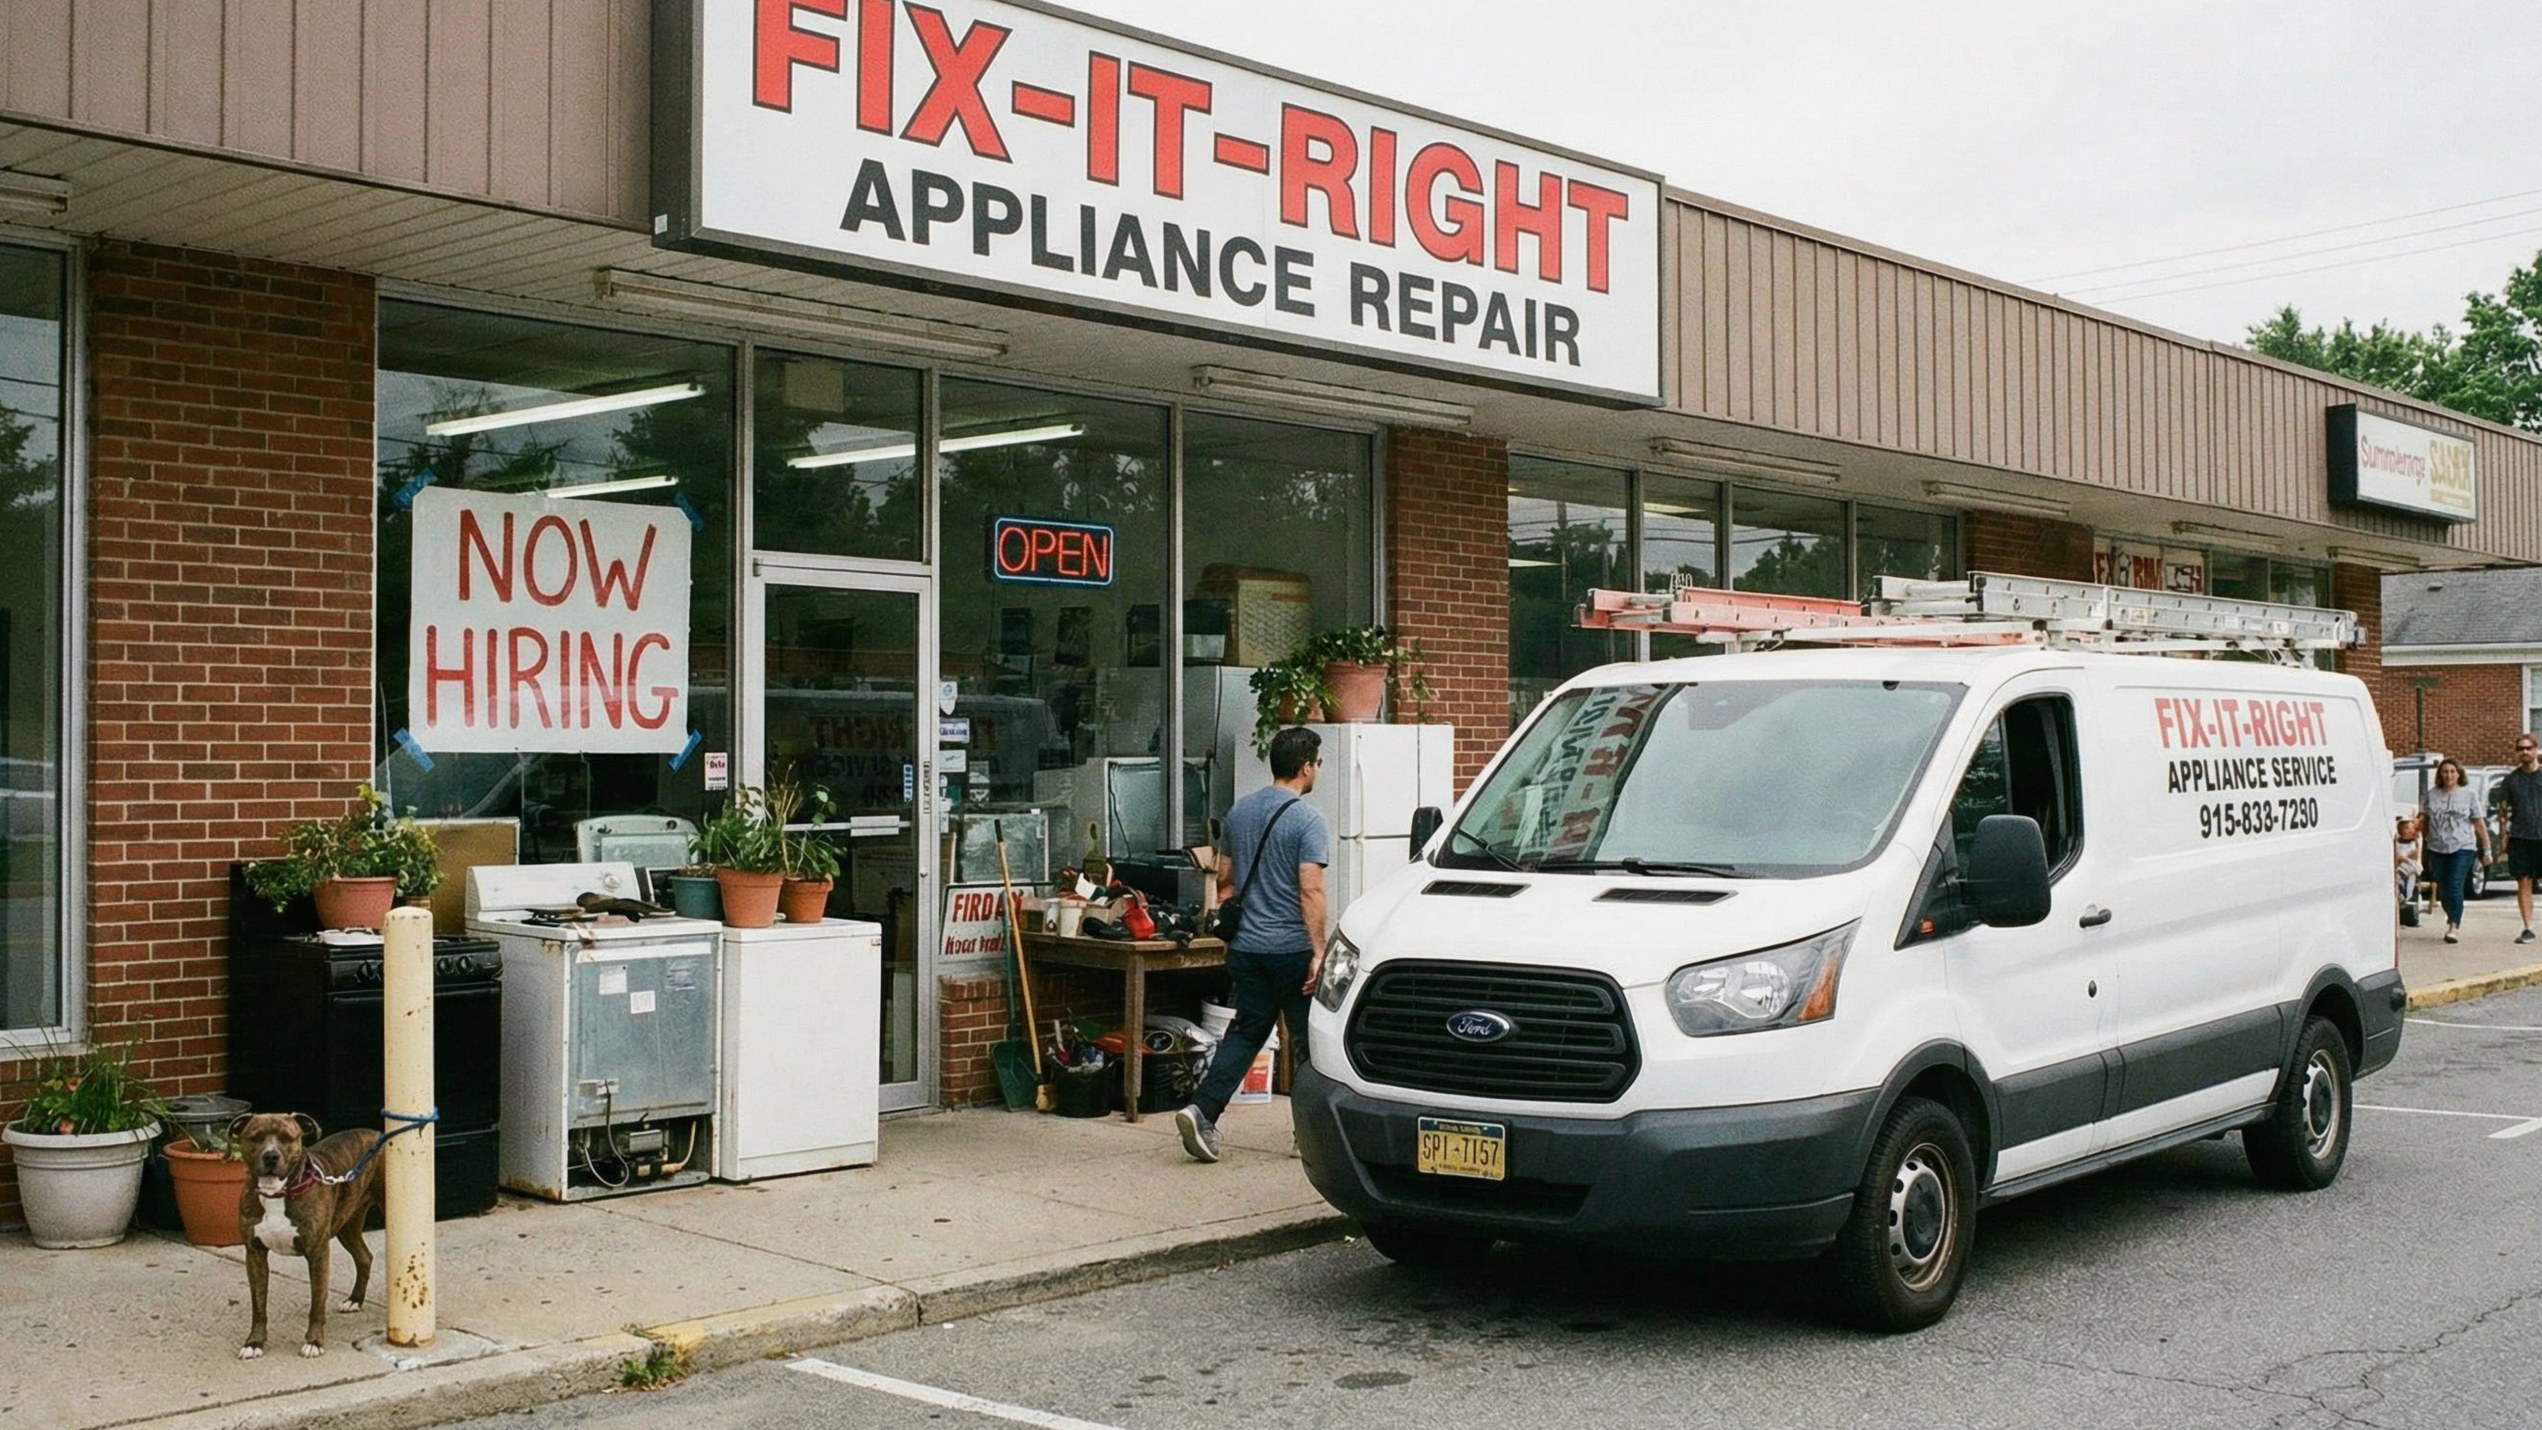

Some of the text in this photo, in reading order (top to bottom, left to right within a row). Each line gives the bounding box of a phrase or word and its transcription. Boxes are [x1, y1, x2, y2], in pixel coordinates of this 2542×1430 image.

[752, 0, 1631, 294] FIX-IT-RIGHT
[839, 158, 1582, 367] APPLIANCE REPAIR
[458, 508, 657, 611] NOW
[998, 526, 1108, 579] OPEN
[426, 624, 679, 729] HIRING
[2154, 697, 2328, 749] FIX-IT-RIGHT
[2168, 755, 2337, 794] APPLIANCE SERVICE
[1457, 1016, 1492, 1036] Ford
